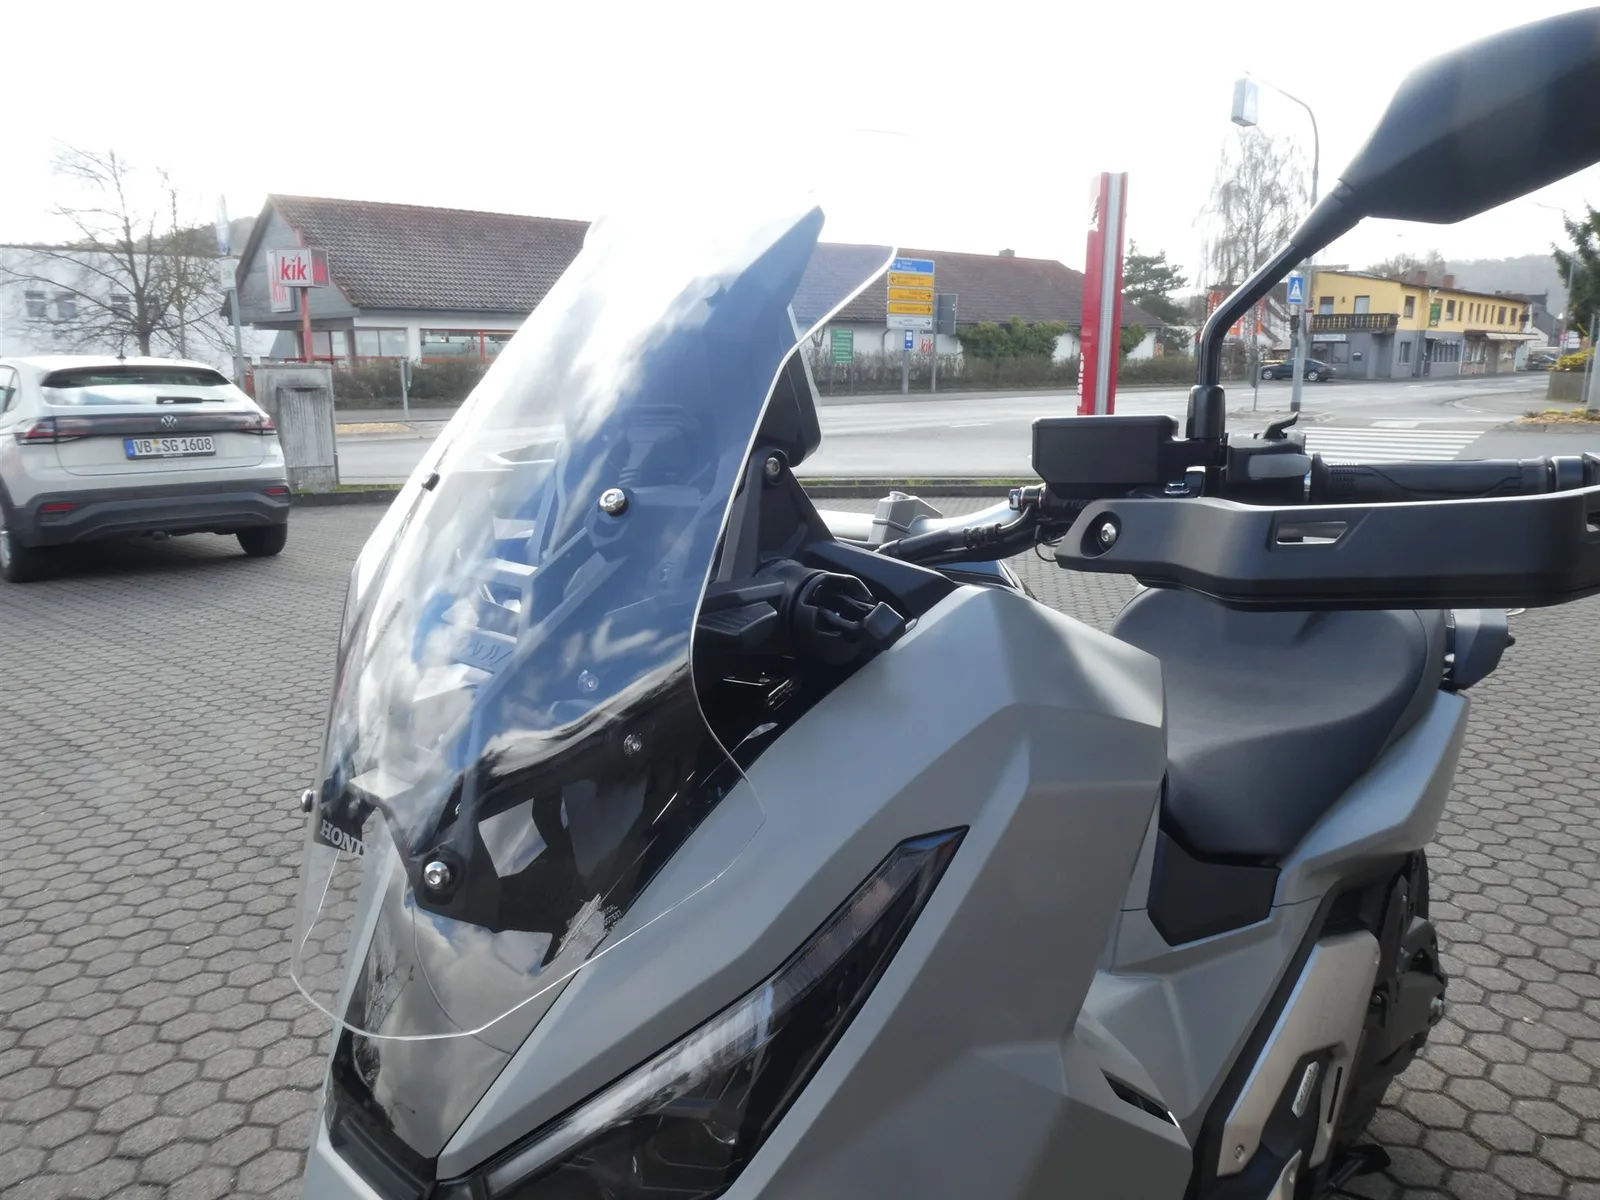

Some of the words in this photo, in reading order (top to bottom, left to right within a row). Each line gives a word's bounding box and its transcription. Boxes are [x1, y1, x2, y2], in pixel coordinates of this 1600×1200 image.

[135, 441, 152, 453] VB
[162, 439, 179, 452] SG
[181, 438, 212, 451] 1608
[320, 819, 365, 857] HOND
